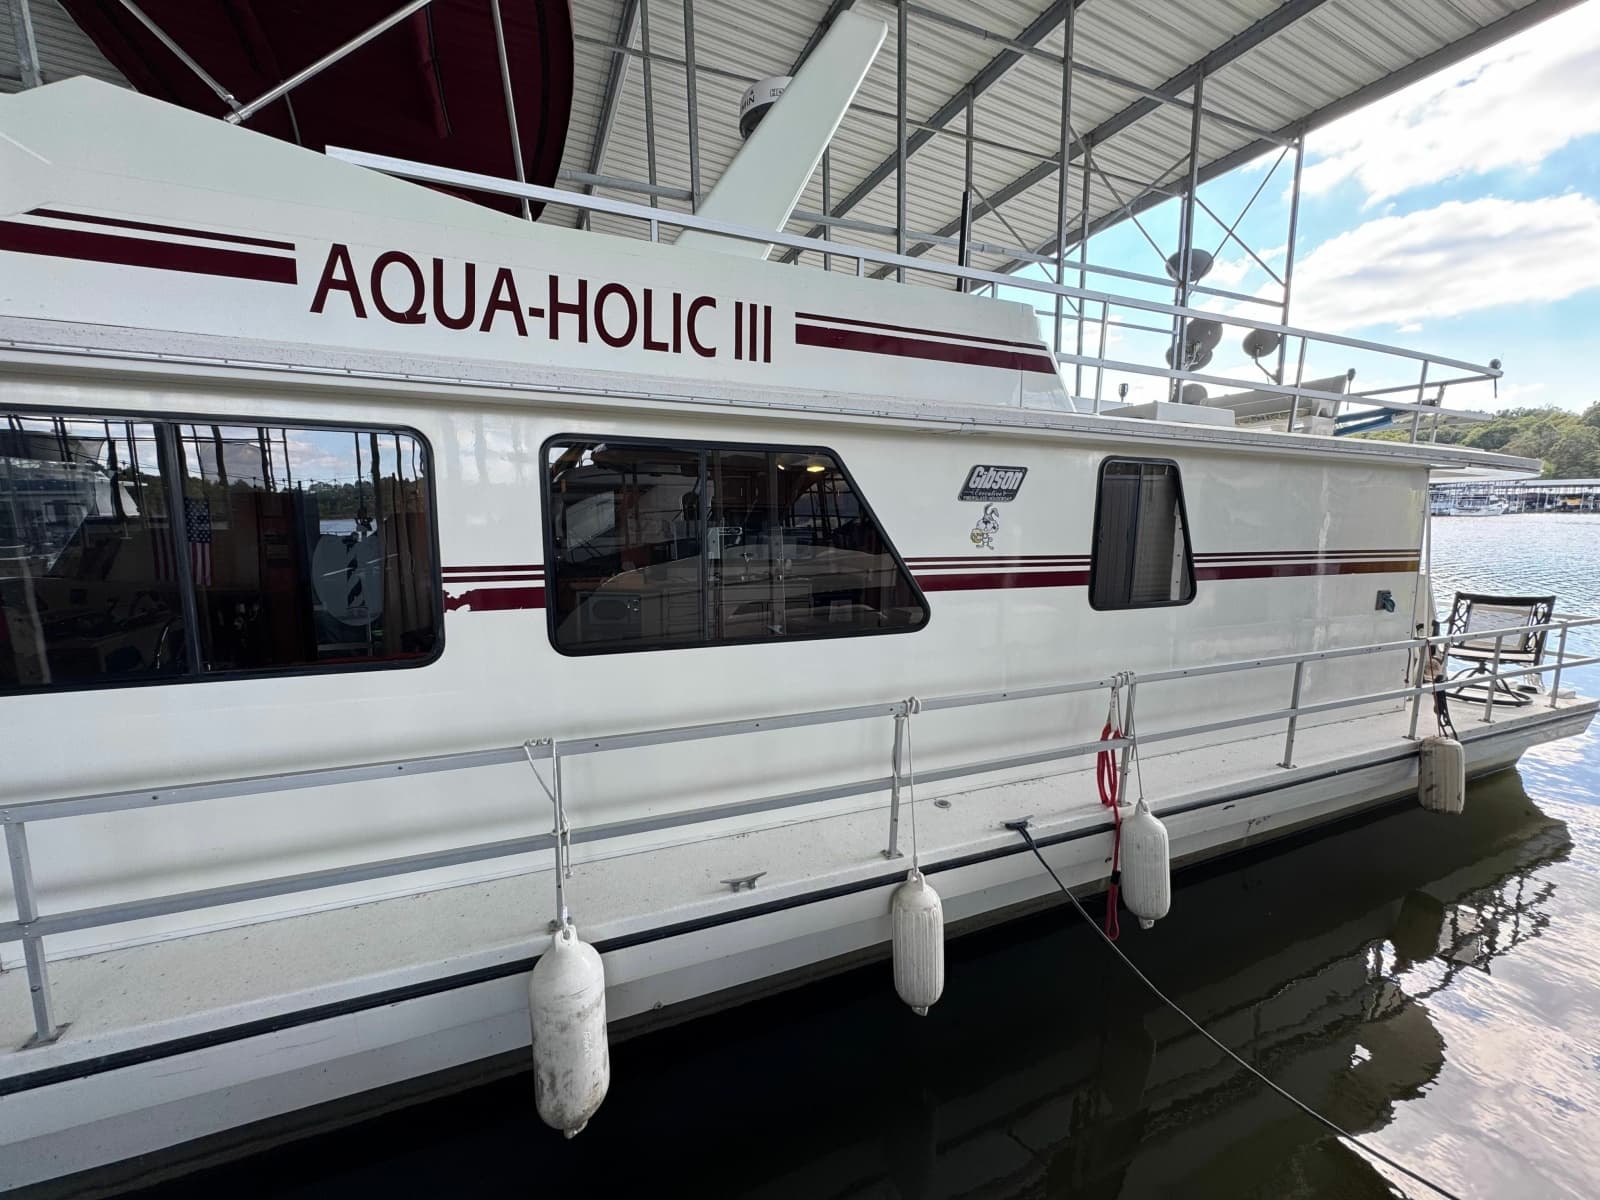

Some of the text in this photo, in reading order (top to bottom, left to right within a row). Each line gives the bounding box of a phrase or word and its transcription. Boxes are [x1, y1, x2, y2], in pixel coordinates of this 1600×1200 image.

[310, 243, 772, 364] AQUA-HOLIC III
[968, 466, 1024, 490] Gibson
